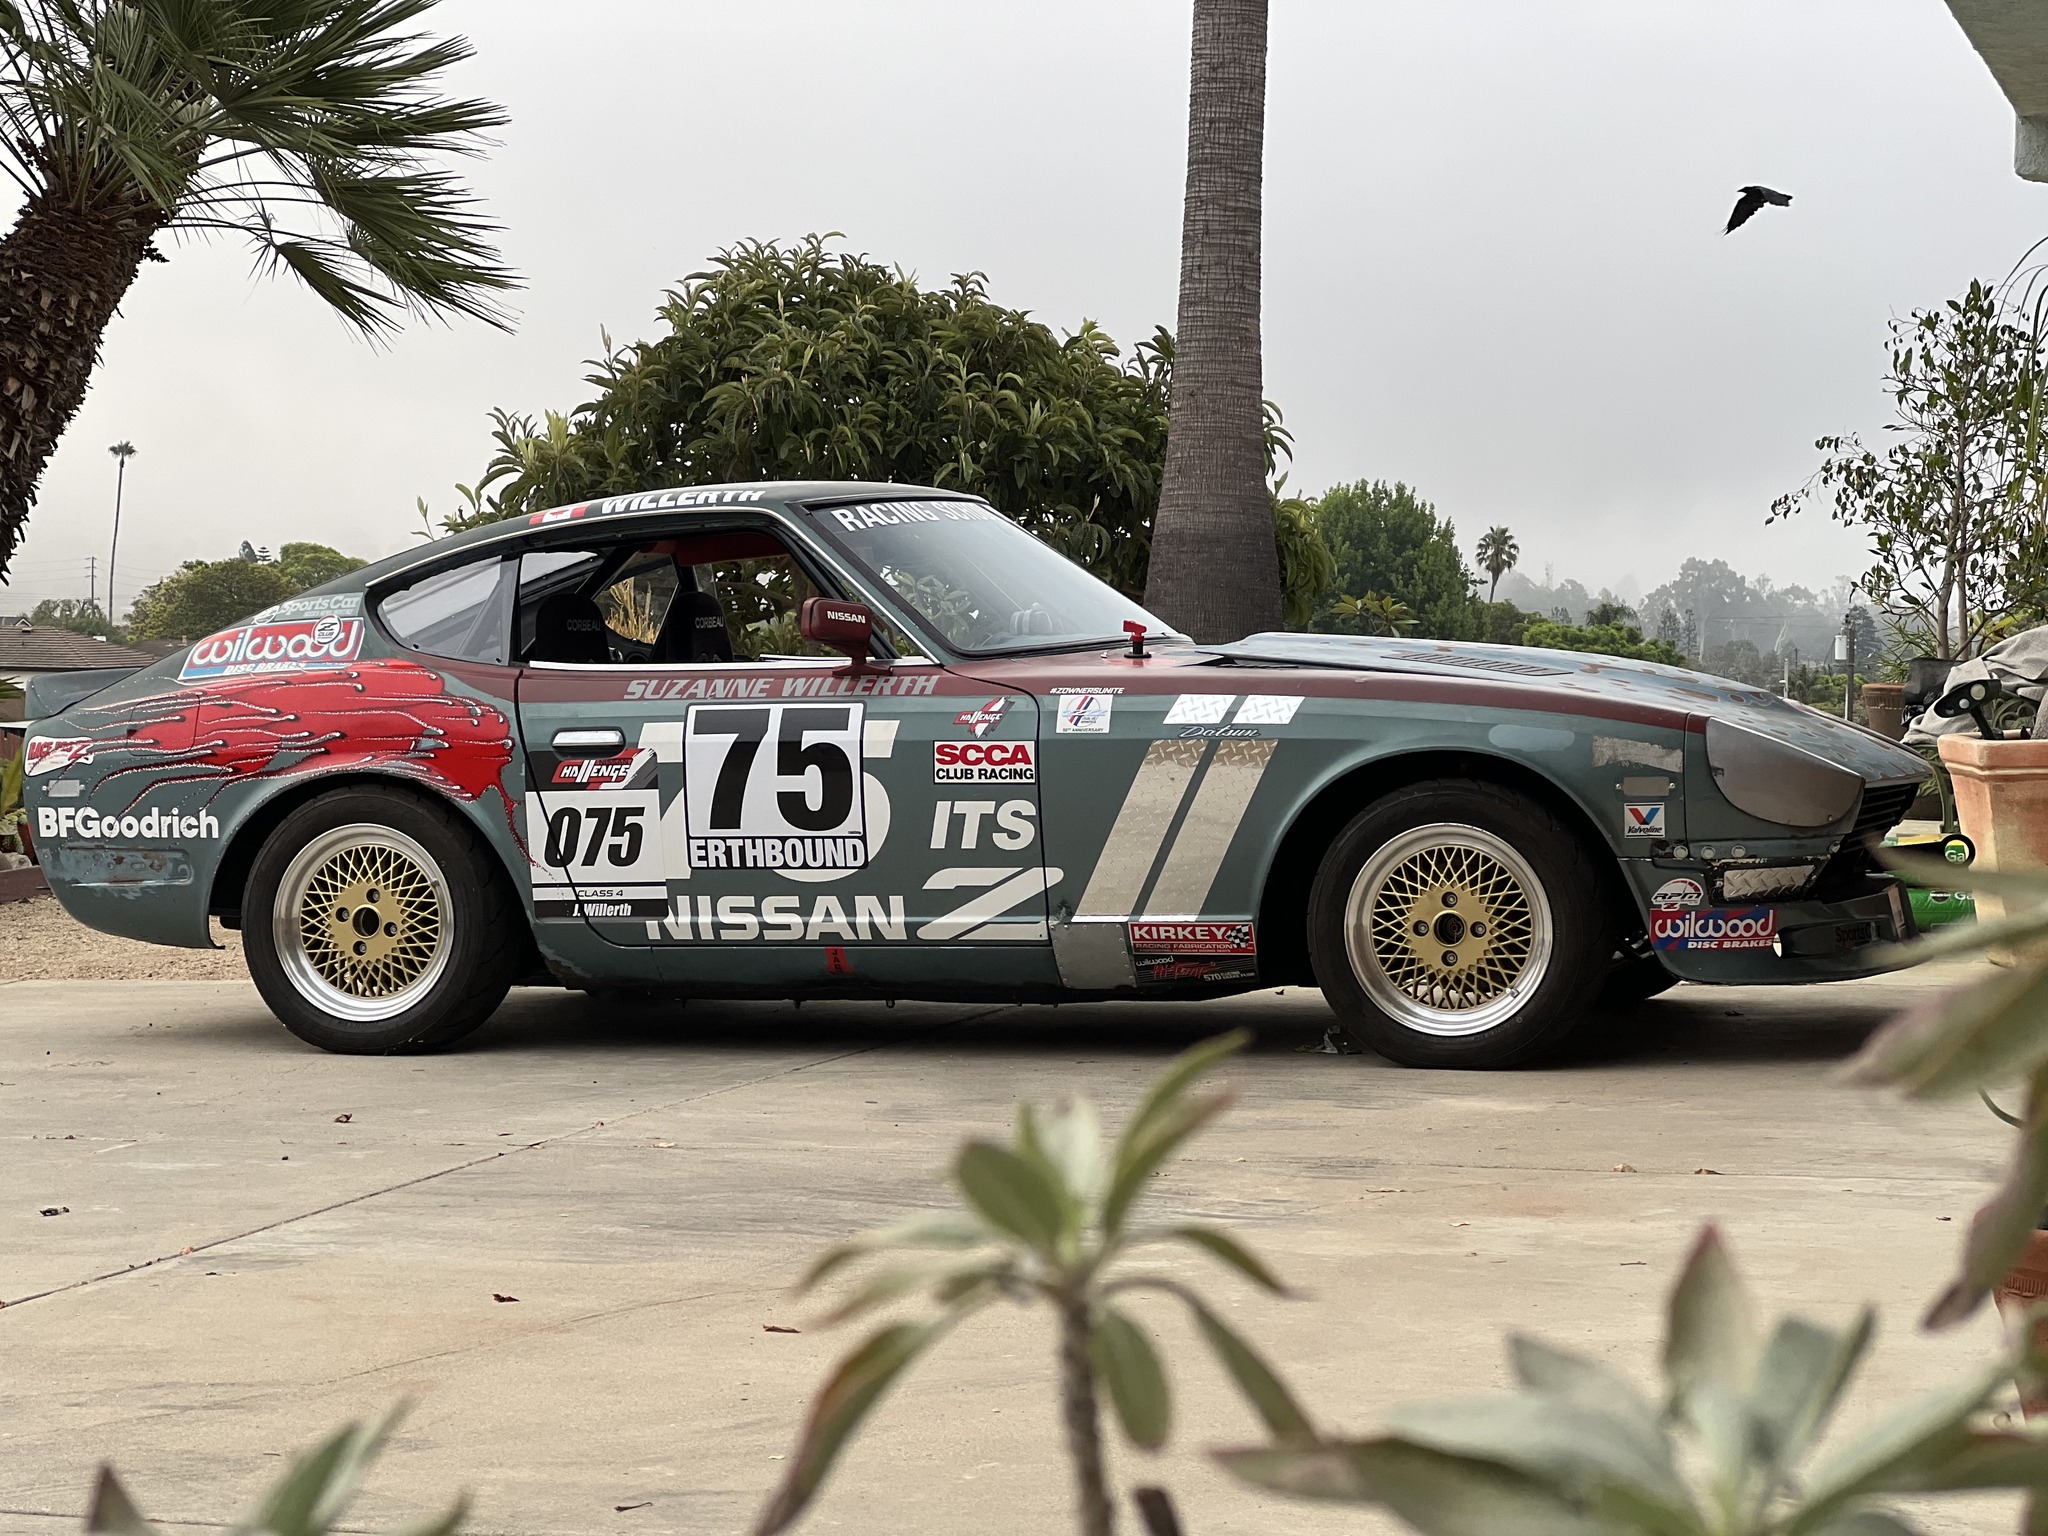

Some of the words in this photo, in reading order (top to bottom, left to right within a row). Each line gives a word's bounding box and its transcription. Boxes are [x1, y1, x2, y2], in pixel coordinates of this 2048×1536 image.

[602, 491, 765, 514] WILLERTH
[831, 501, 940, 532] RACING
[281, 596, 361, 615] SportsCar
[695, 616, 724, 629] CORBEAU
[827, 610, 866, 624] NISSAN
[566, 619, 600, 631] CORBEAU
[225, 662, 254, 675] DISC
[623, 679, 774, 700] SUZANNE
[782, 675, 941, 698] WILLERTH
[1049, 687, 1126, 695] #ZOWNERSUNITE
[1178, 724, 1262, 739] Datsun
[935, 744, 1033, 766] SCCA
[693, 707, 854, 832] 75
[936, 768, 974, 780] CLUB
[978, 768, 1034, 780] RACING
[38, 806, 219, 839] BFGoodrich
[930, 799, 1037, 851] ITS
[544, 806, 646, 868] 075
[1627, 825, 1663, 835] Valvoline
[690, 838, 864, 868] ERTHBOUND
[578, 889, 613, 898] CLASS
[616, 889, 624, 897] 4
[572, 903, 581, 917] J.
[583, 903, 632, 917] Willerth
[645, 895, 908, 941] NISSAN
[1654, 909, 1774, 938] wilwood
[1133, 926, 1228, 940] KIRKEY
[1173, 942, 1233, 950] FABRICATION
[1687, 941, 1719, 949] DISC
[1722, 939, 1773, 949] BRAKES
[1135, 955, 1174, 967] wilwood
[1203, 973, 1222, 982] 570
